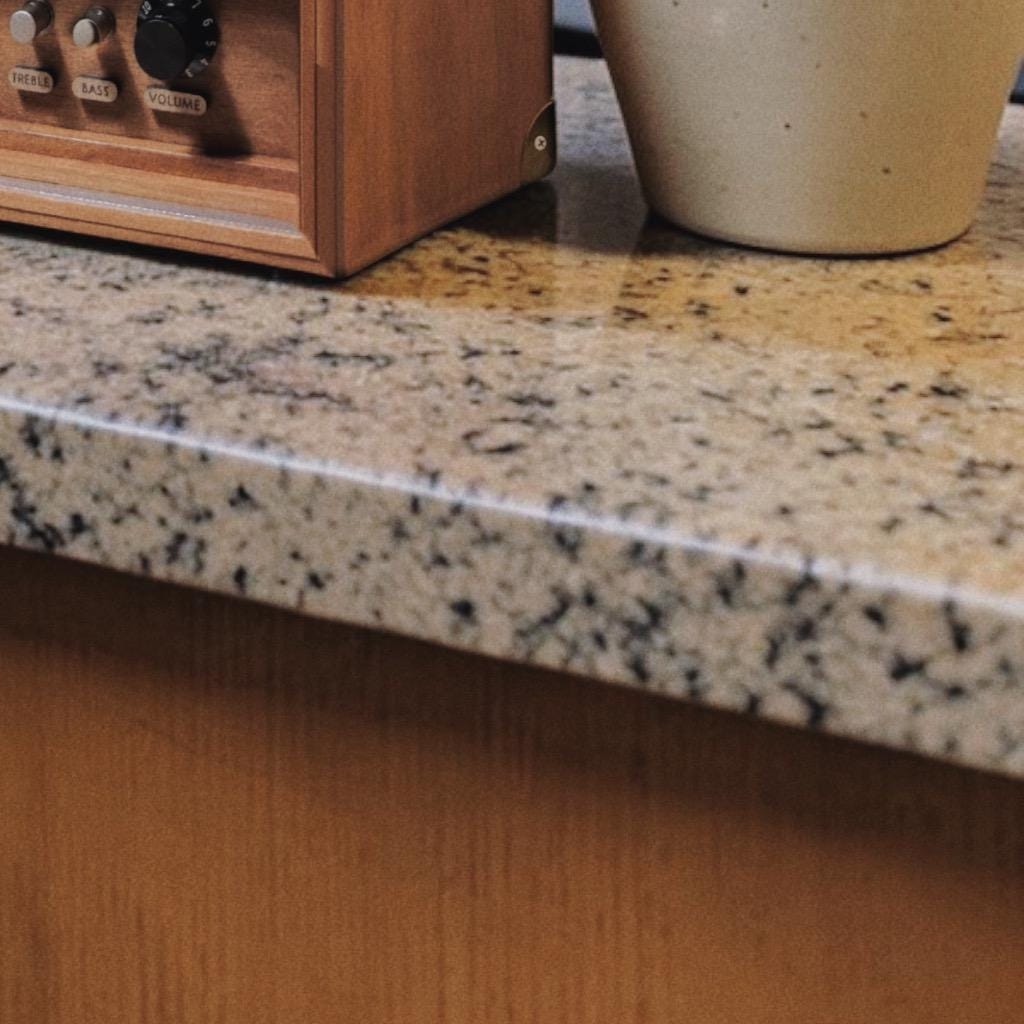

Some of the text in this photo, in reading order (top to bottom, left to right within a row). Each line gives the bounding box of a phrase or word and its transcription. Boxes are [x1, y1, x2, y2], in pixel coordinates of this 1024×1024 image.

[12, 72, 50, 88] TREBLE
[82, 82, 110, 97] BASS
[148, 90, 201, 112] VOLUME
